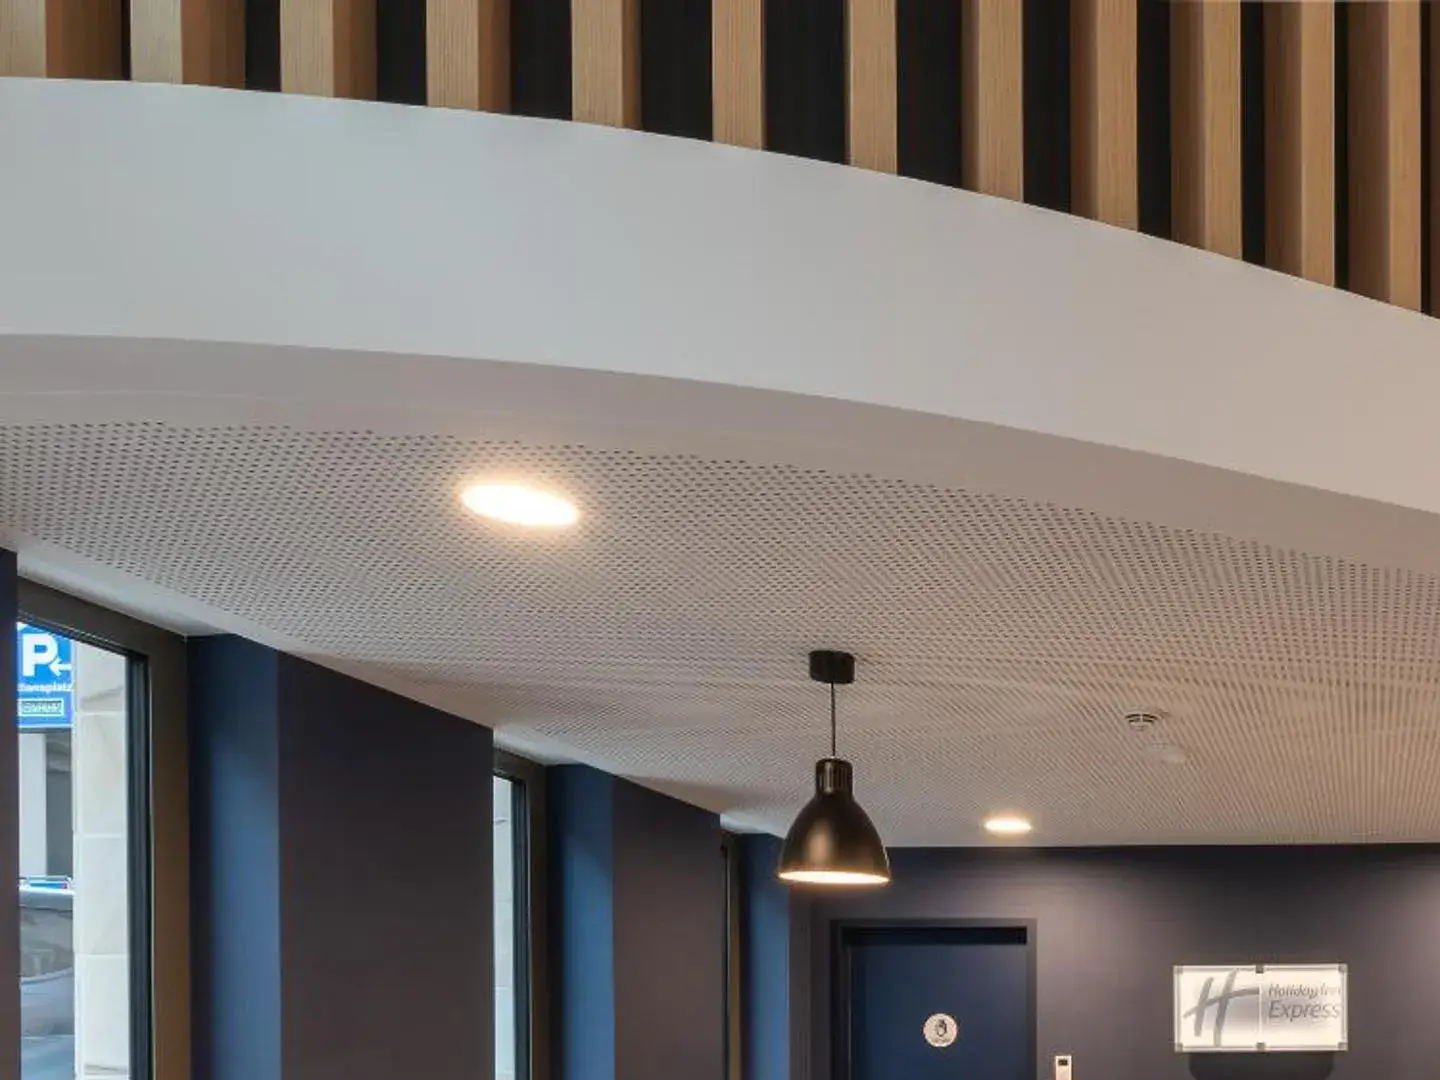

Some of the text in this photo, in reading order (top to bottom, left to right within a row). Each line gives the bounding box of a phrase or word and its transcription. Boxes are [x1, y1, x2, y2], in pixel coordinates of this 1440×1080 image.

[22, 633, 58, 676] P
[1268, 983, 1319, 999] Holiday
[1268, 1001, 1341, 1022] Express
